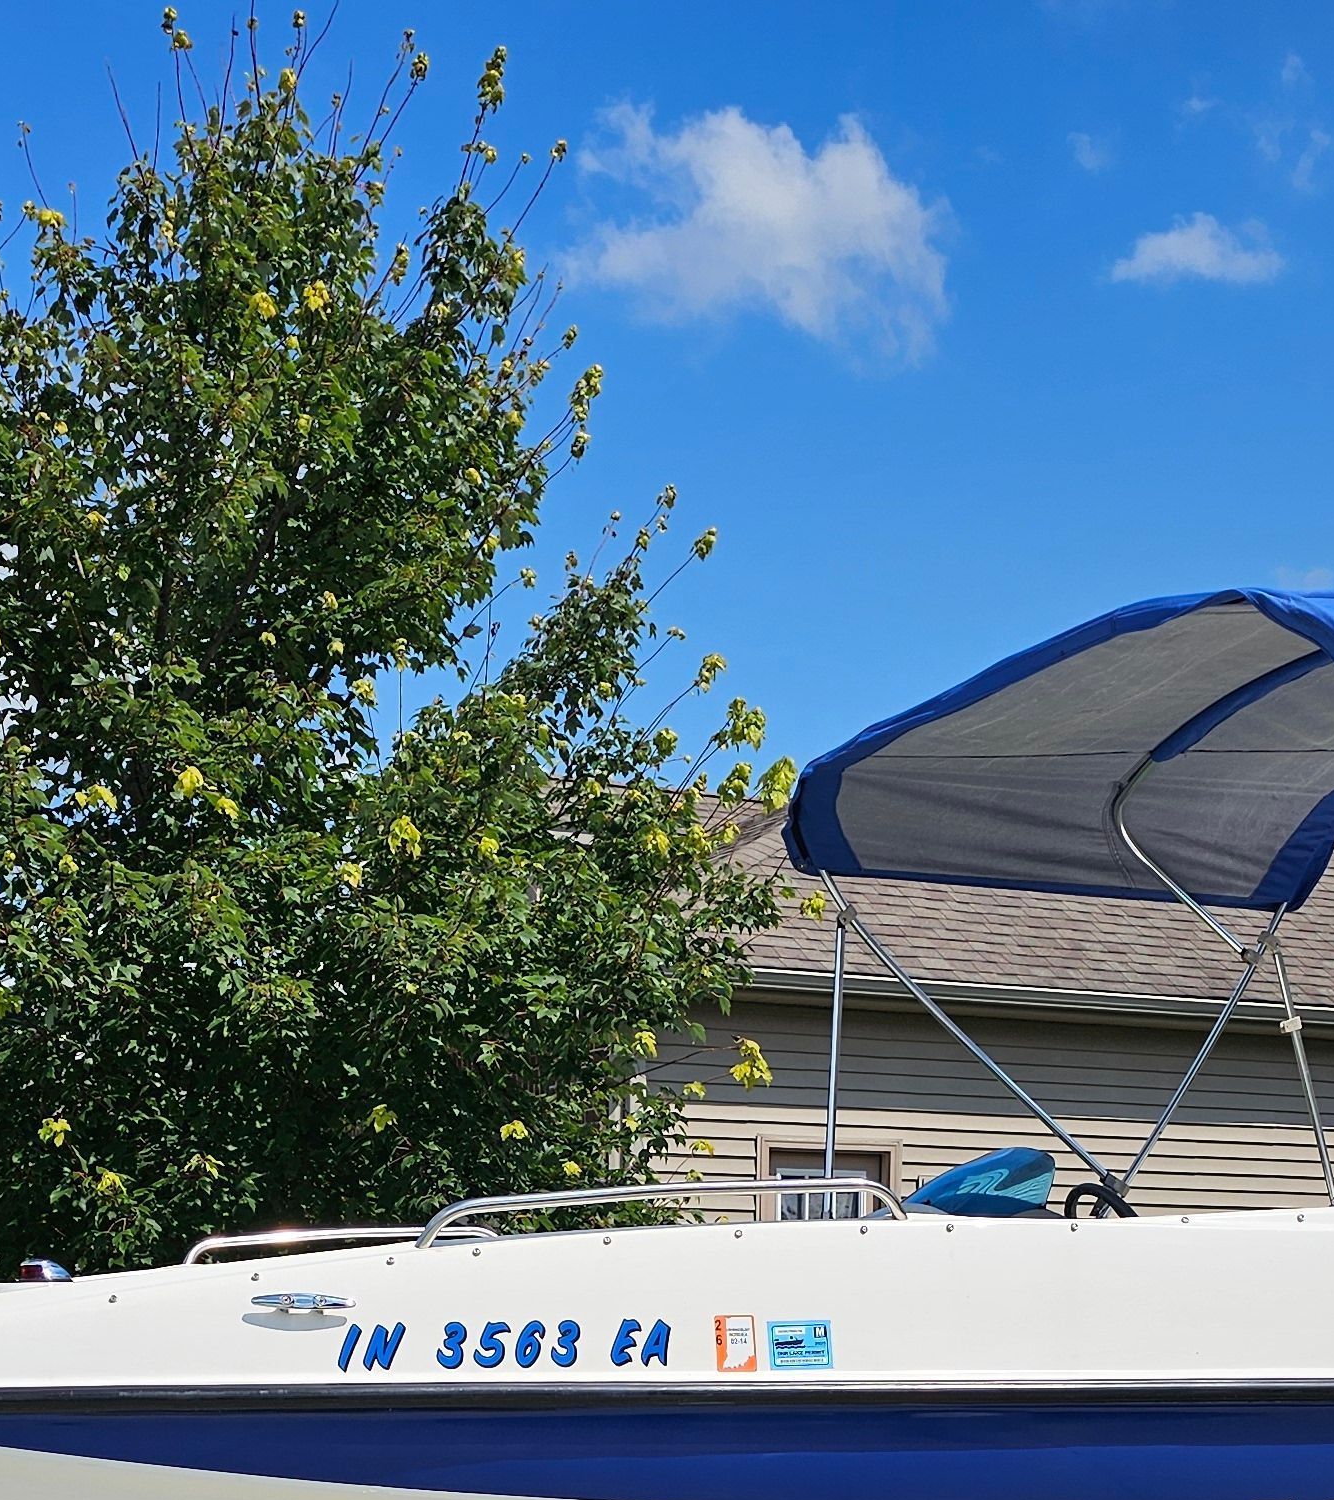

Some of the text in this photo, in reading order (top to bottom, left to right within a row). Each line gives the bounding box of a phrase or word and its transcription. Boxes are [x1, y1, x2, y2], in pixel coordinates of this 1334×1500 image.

[337, 1318, 672, 1373] IN 3563 EA
[815, 1326, 826, 1338] M
